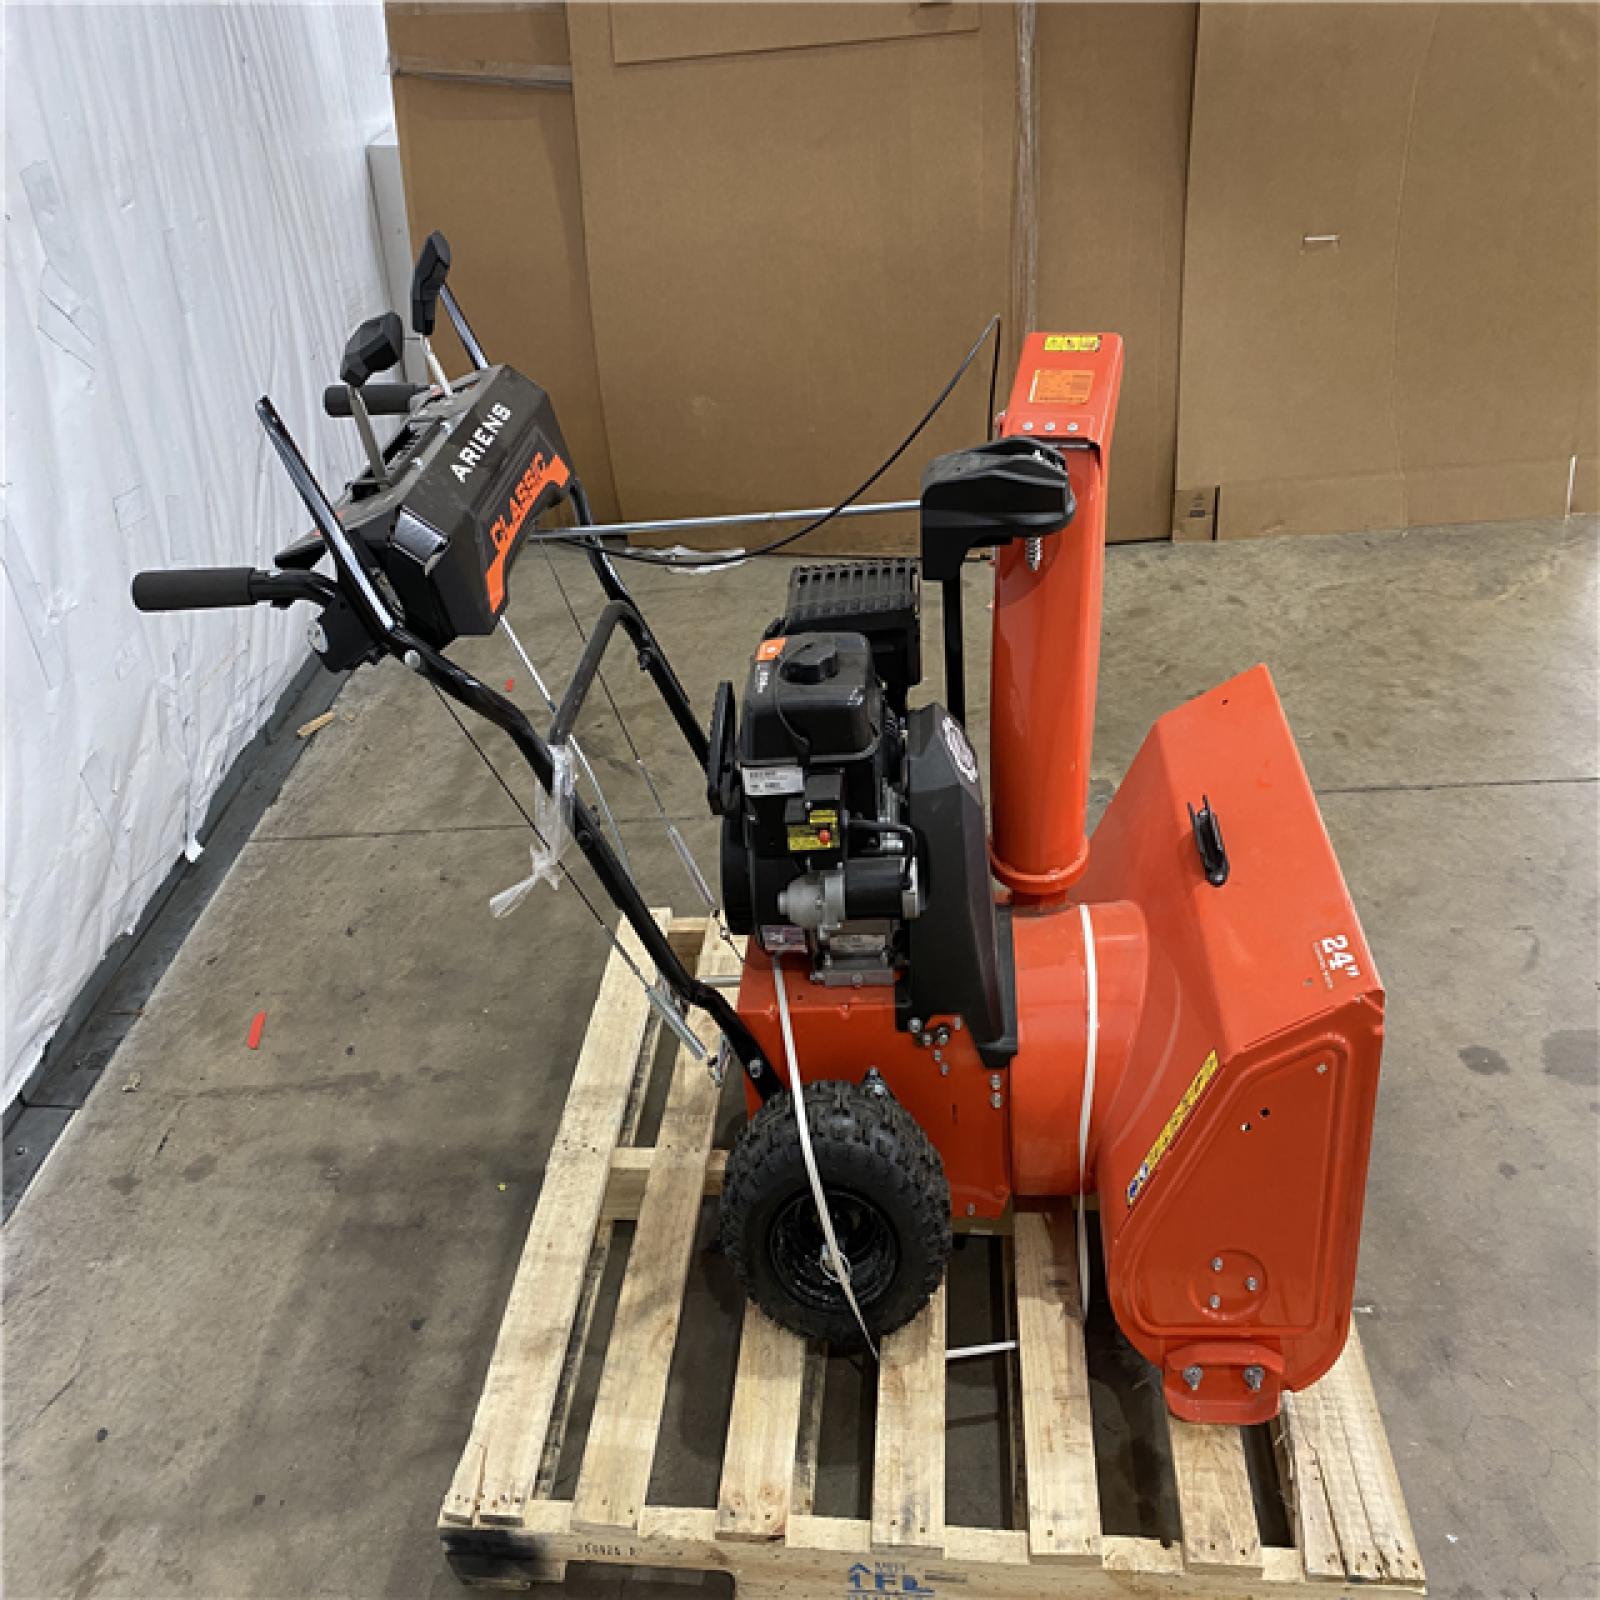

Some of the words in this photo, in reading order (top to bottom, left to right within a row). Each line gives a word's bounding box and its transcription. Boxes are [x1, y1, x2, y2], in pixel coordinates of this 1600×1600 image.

[450, 402, 512, 482] ARIENS
[489, 452, 546, 546] CLASSIC
[1320, 935, 1361, 976] 24"
